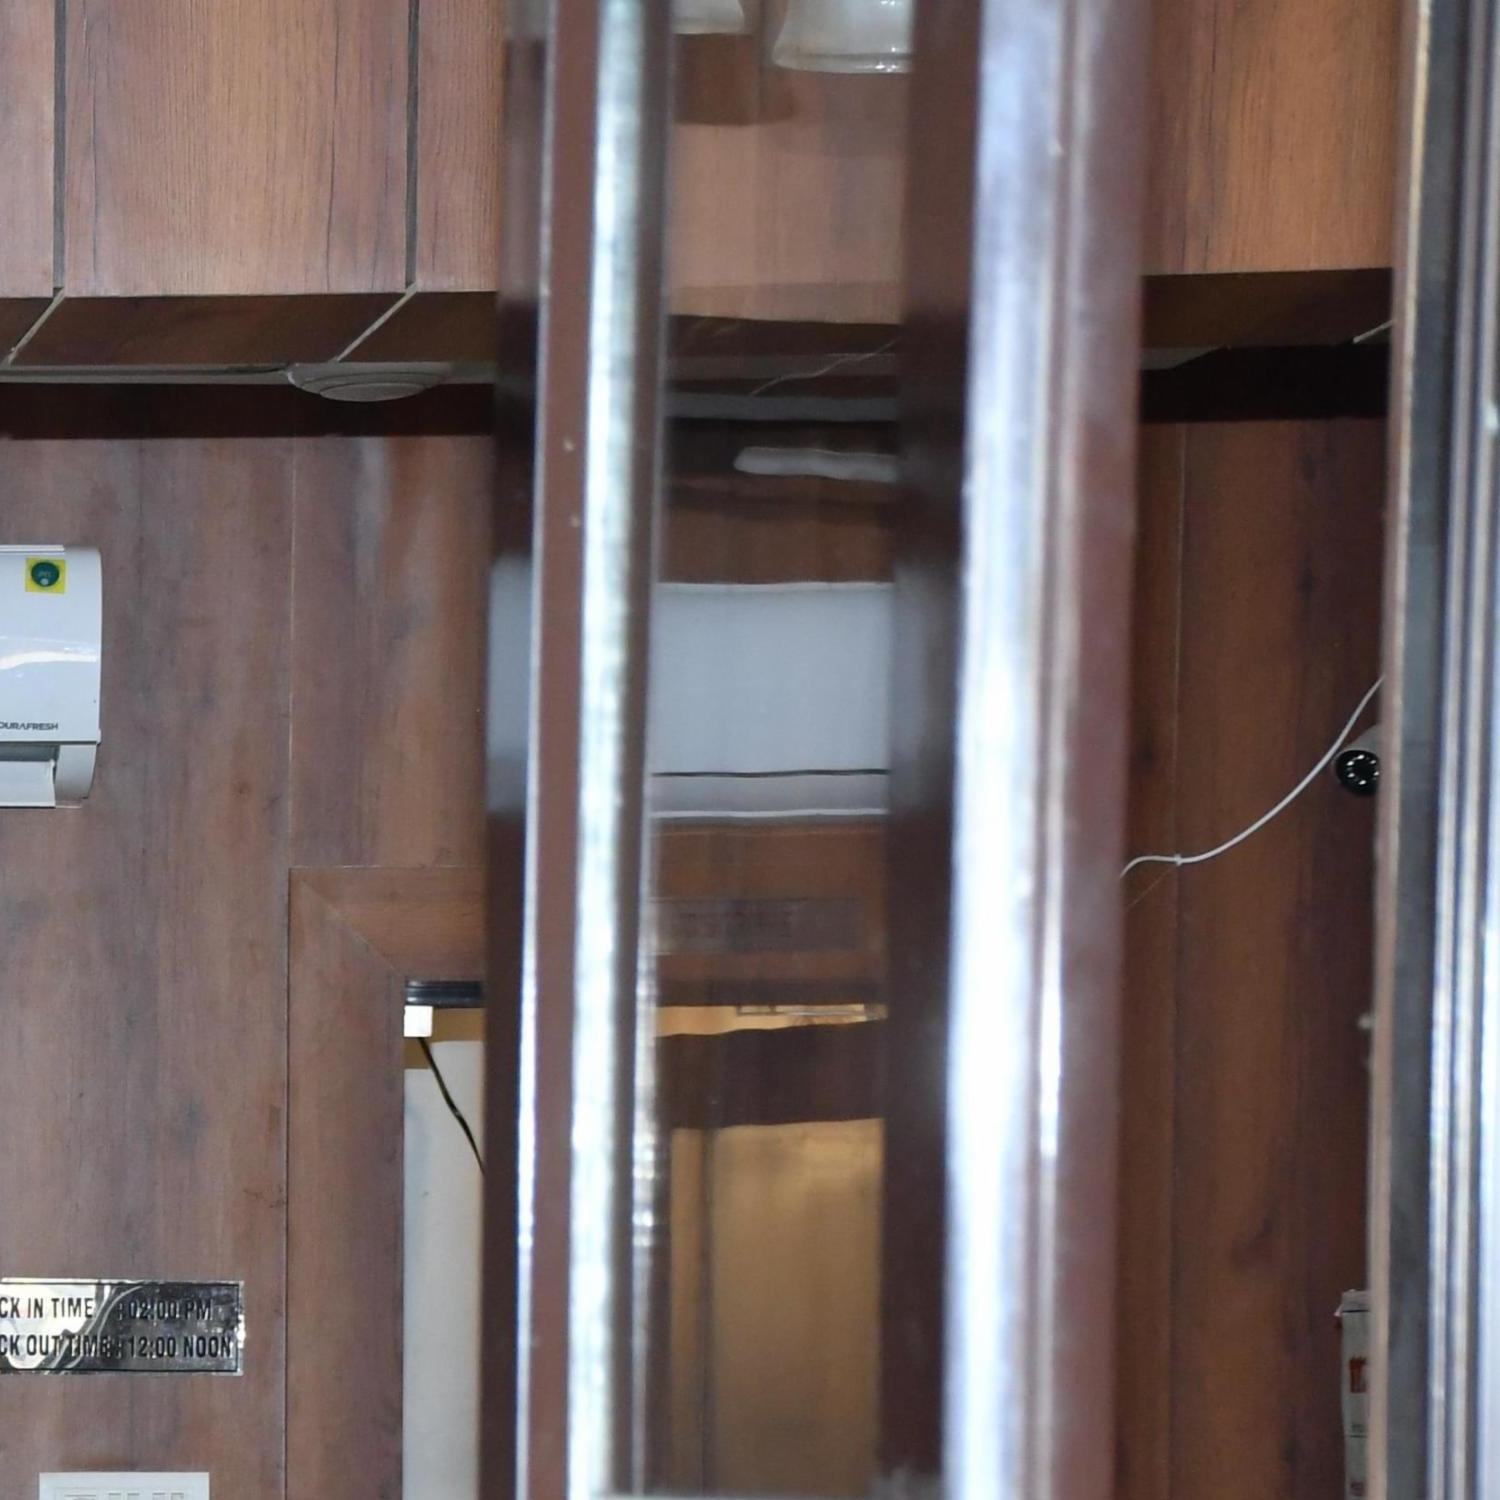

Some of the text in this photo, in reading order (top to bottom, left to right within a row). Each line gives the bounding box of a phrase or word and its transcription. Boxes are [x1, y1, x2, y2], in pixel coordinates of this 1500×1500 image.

[27, 1296, 43, 1319] IN
[50, 1297, 93, 1319] TIME
[128, 1302, 177, 1320] 02:00
[184, 1302, 211, 1320] PM
[27, 1335, 60, 1356] OUT
[130, 1335, 176, 1358] 12:00
[183, 1336, 231, 1358] NOON
